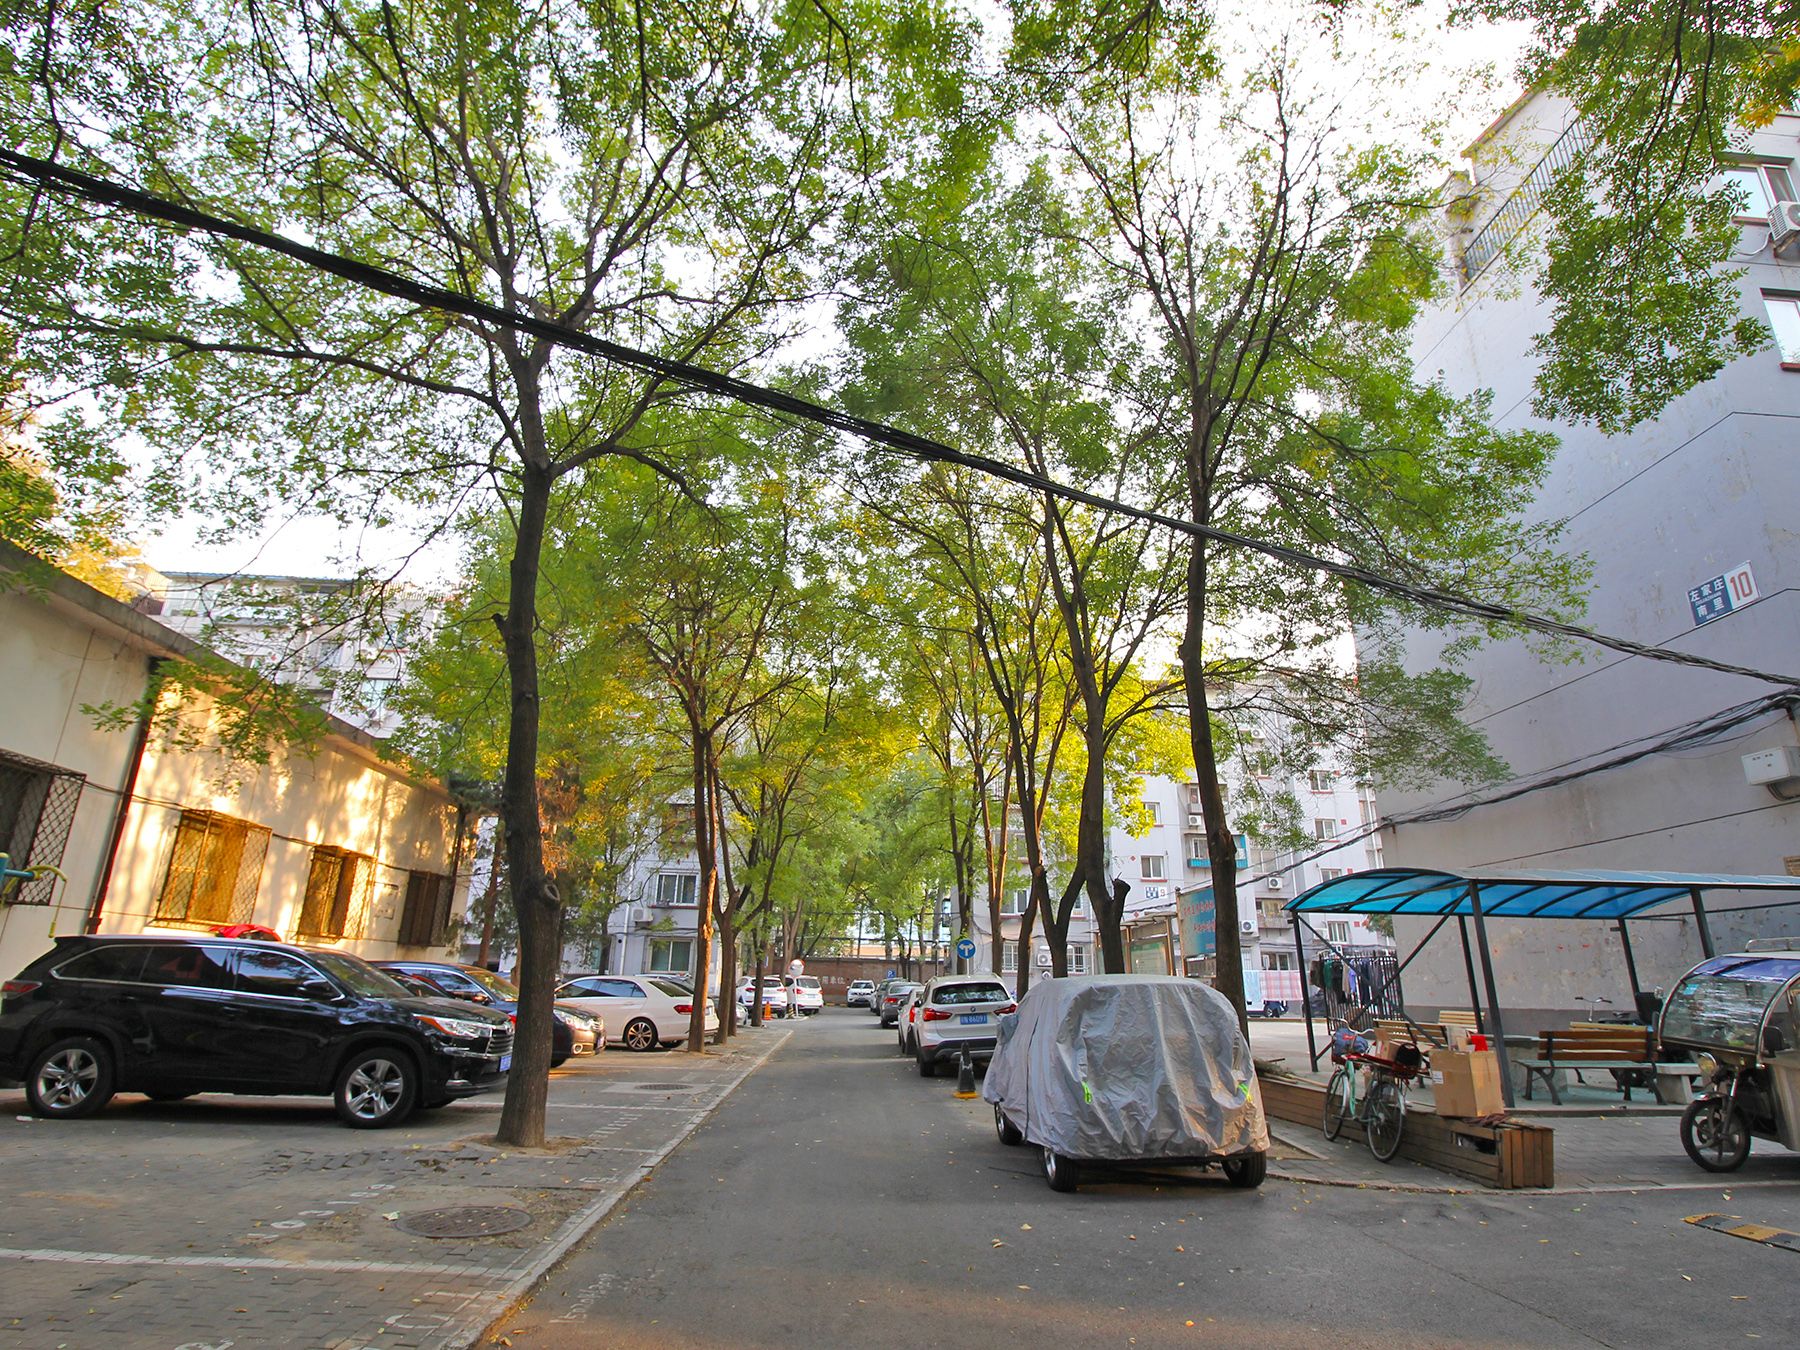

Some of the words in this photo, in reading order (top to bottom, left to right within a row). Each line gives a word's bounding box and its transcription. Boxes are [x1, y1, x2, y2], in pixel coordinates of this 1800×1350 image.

[1689, 578, 1725, 602] 左家庄
[1730, 571, 1753, 601] 10
[1696, 596, 1725, 618] 南里
